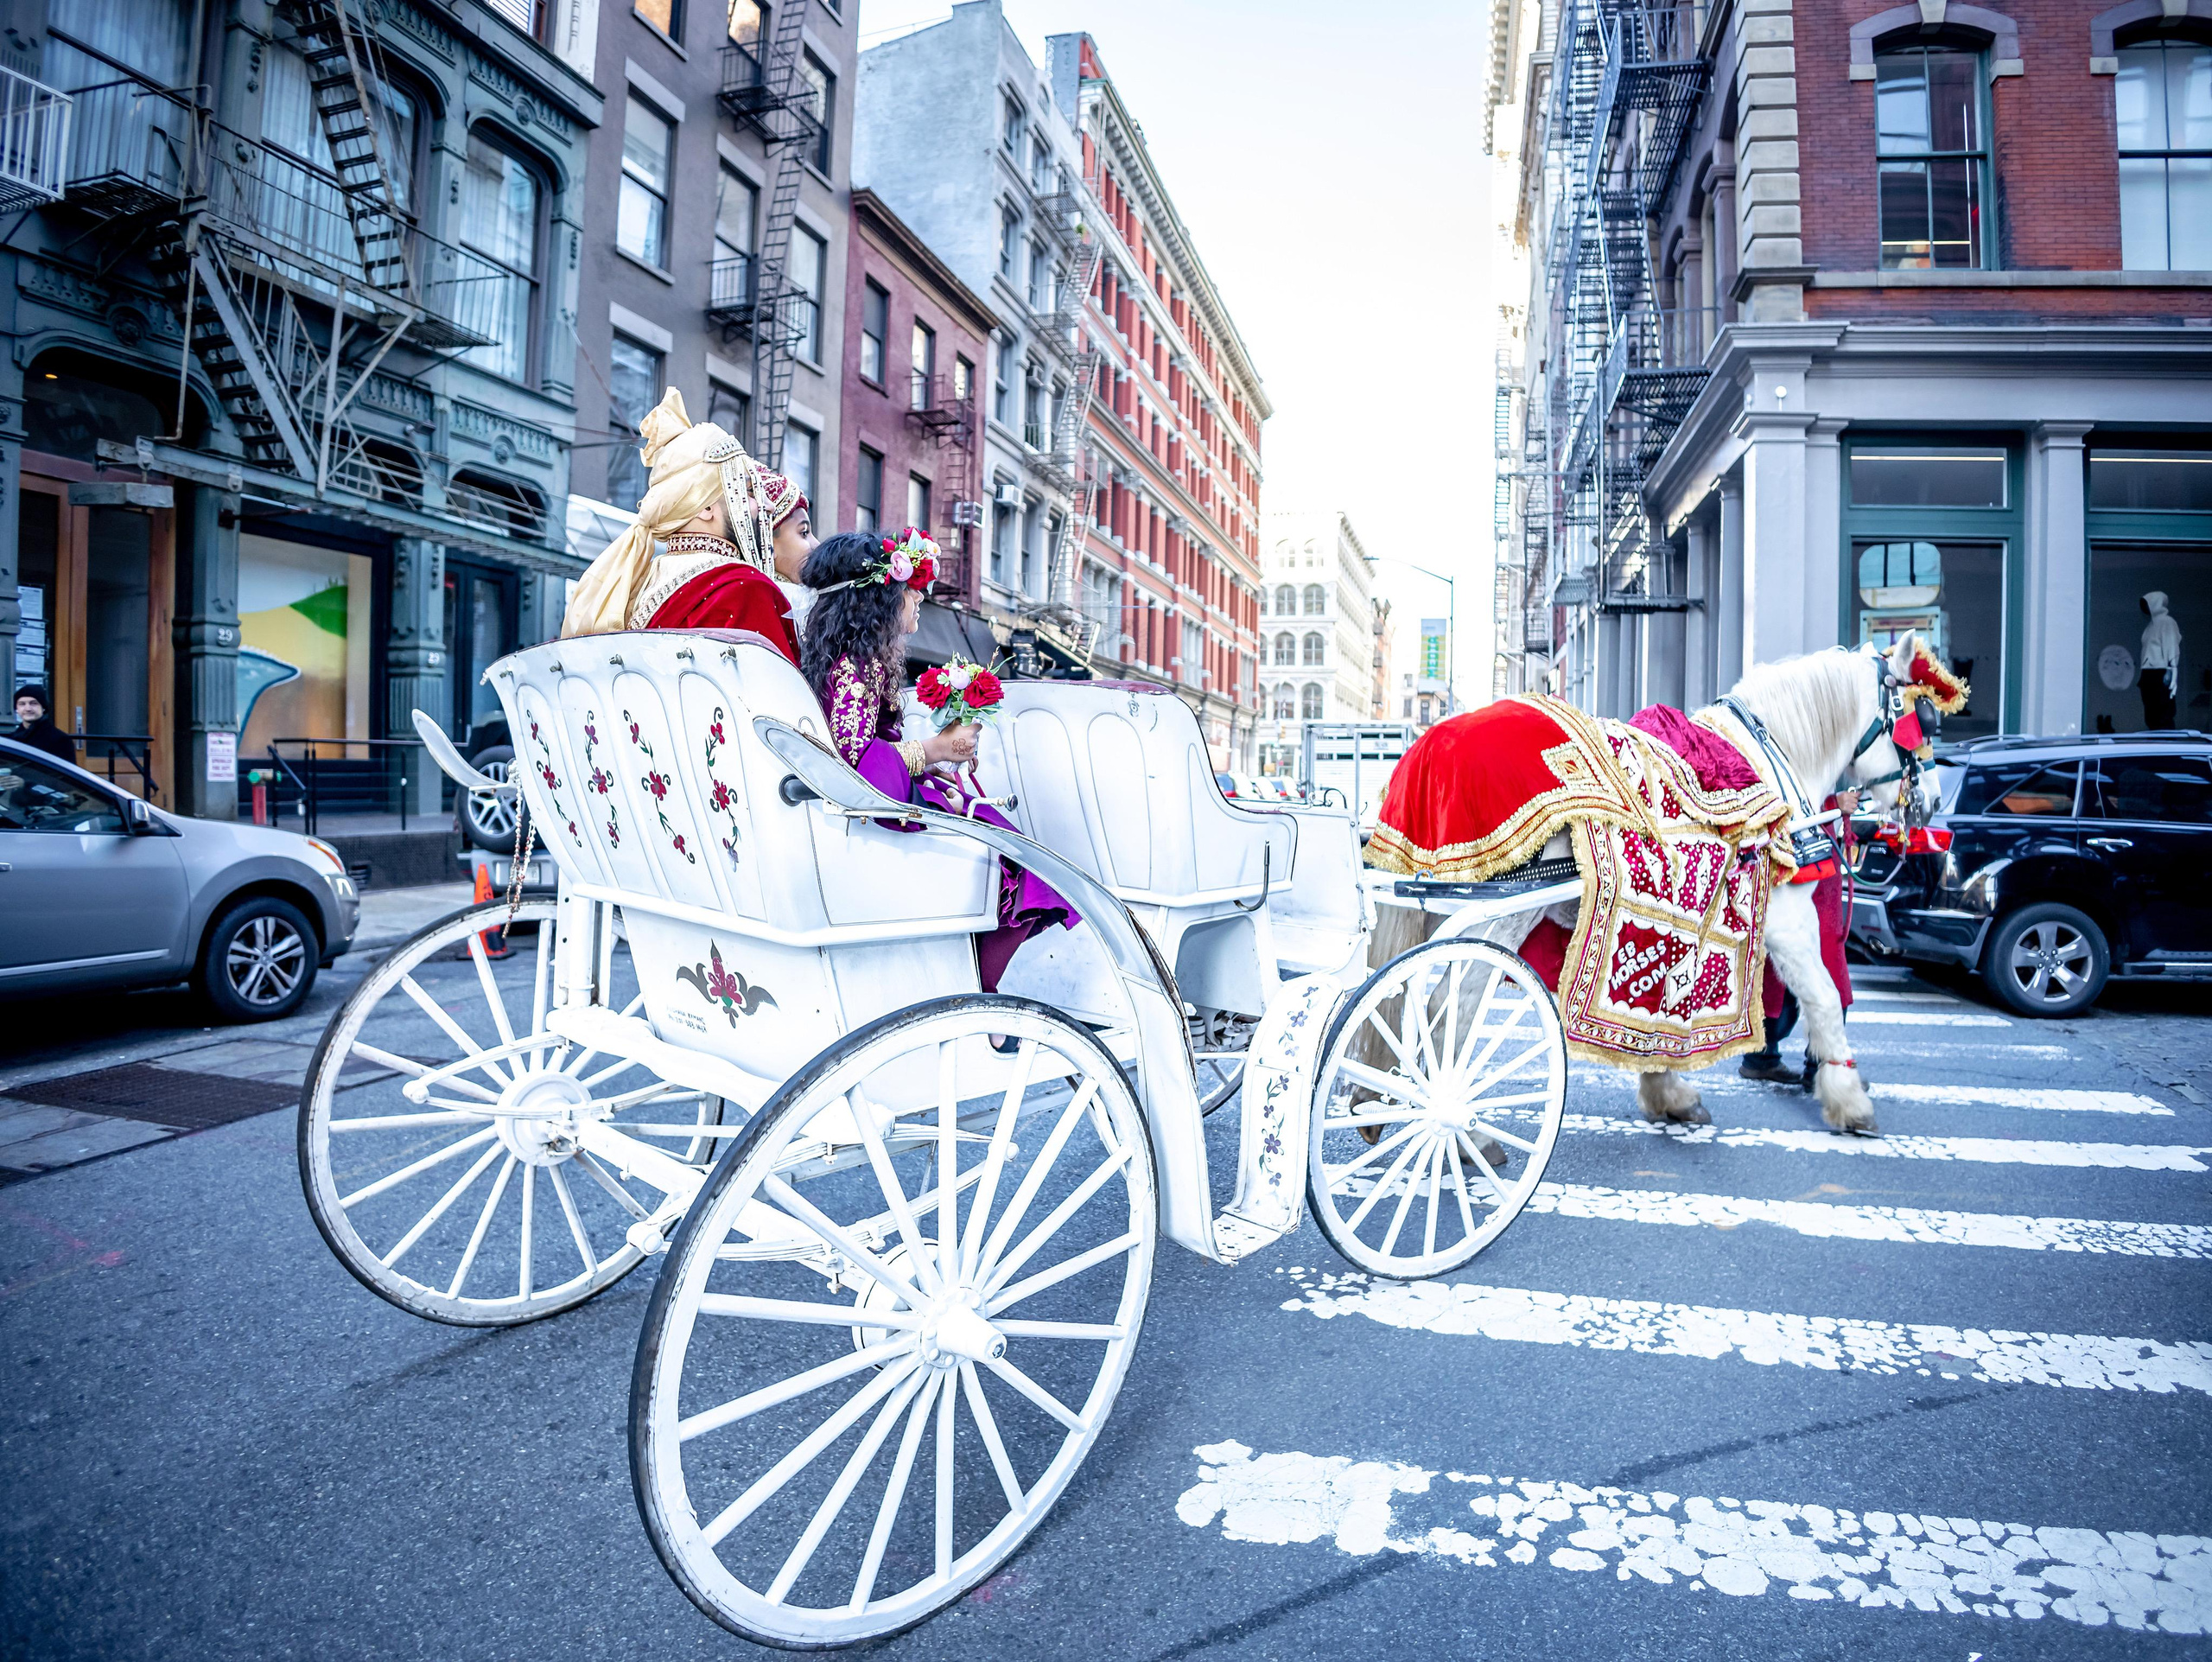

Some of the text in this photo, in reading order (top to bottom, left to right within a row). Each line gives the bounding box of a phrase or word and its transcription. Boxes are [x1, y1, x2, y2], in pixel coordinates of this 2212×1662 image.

[218, 627, 233, 642] 29
[1611, 939, 1667, 991] HORSES
[1618, 940, 1637, 965] EB
